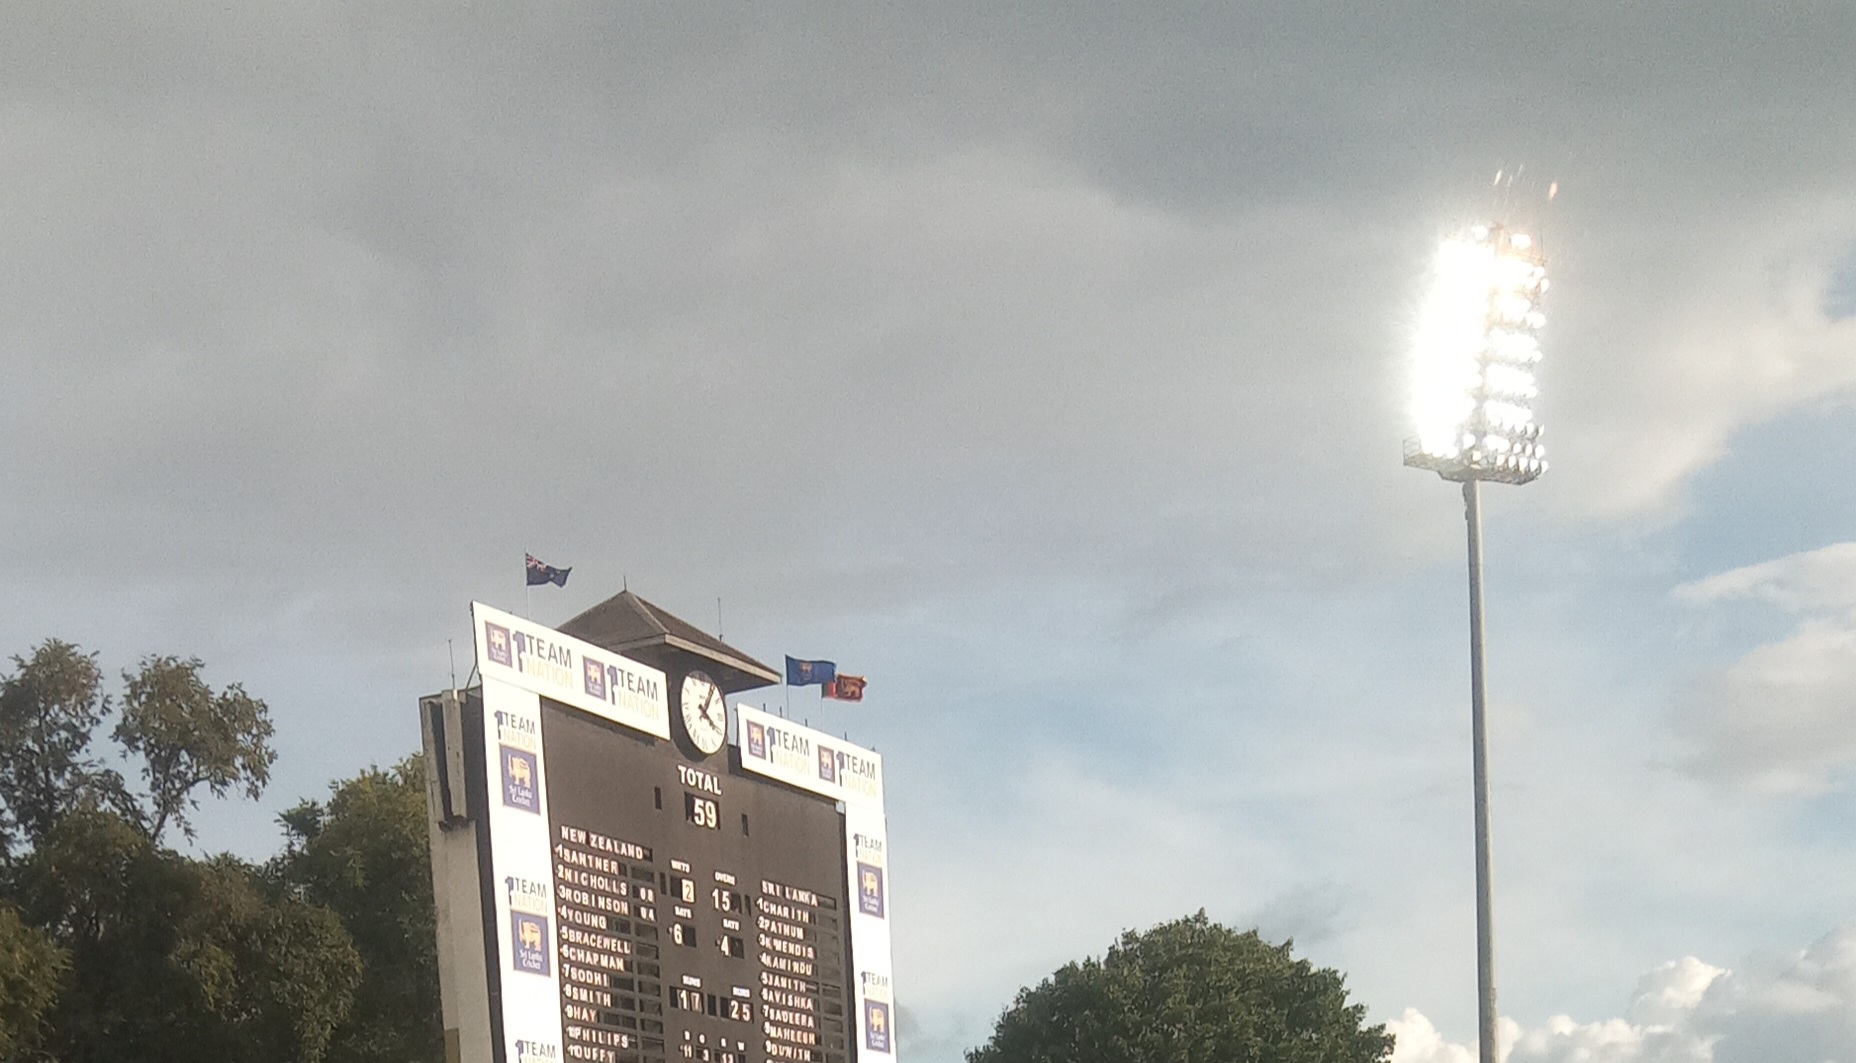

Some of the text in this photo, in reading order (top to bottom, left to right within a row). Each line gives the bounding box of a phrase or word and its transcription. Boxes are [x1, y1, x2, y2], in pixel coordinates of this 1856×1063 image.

[526, 634, 572, 669] TEAM
[618, 668, 658, 701] TEAM
[504, 712, 535, 734] TEAM
[776, 729, 809, 756] TEAM
[846, 753, 876, 780] TEAM
[678, 764, 722, 796] TOTAL
[694, 798, 717, 828] 59
[561, 825, 643, 860] NEW ZEALAND
[859, 835, 882, 852] TEAM
[563, 848, 618, 875] SANTNER
[515, 877, 546, 898] TEAM
[564, 868, 627, 896] NICHOLLS
[762, 880, 818, 907] SRI LANKA
[565, 888, 629, 915] ROBINSON
[712, 888, 730, 911] 15
[567, 908, 607, 930] YOUNG
[763, 900, 809, 924] CHARITH
[673, 923, 683, 945] 6
[765, 919, 804, 940] PATHUM
[568, 929, 631, 954] BRACEWELL
[721, 935, 729, 956] 4
[569, 947, 624, 972] CHAPMAN
[570, 966, 609, 987] SODHI
[572, 986, 611, 1007] SMITH
[680, 989, 700, 1010] 17
[768, 990, 814, 1011] AVISHKA
[573, 1005, 597, 1022] HAY
[731, 1000, 750, 1021] 25
[575, 1026, 628, 1049] PHILIPS
[524, 1041, 555, 1058] TEAM
